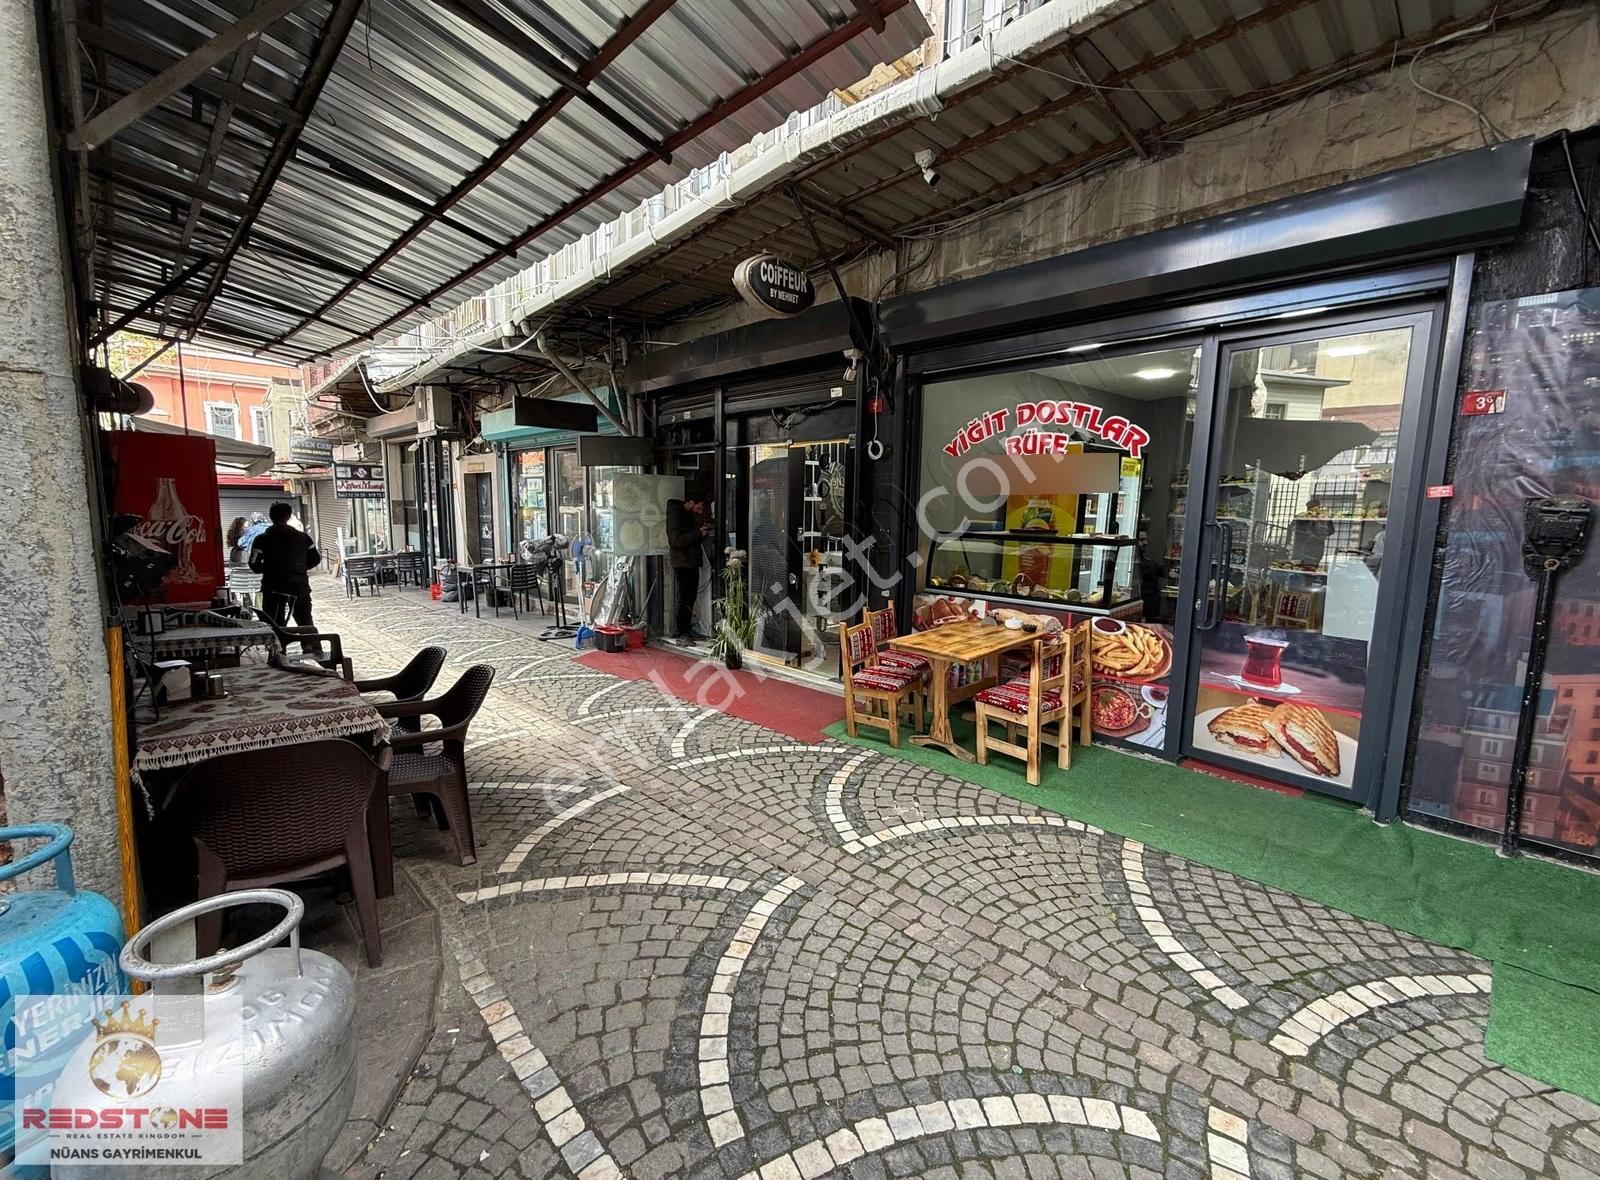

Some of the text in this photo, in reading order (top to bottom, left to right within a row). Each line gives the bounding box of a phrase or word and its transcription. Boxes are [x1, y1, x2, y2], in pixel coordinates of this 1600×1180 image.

[770, 287, 800, 304] BY MEHMET
[943, 400, 1150, 459] YİĞİT DOSTLAR
[1005, 428, 1070, 455] BÜFE
